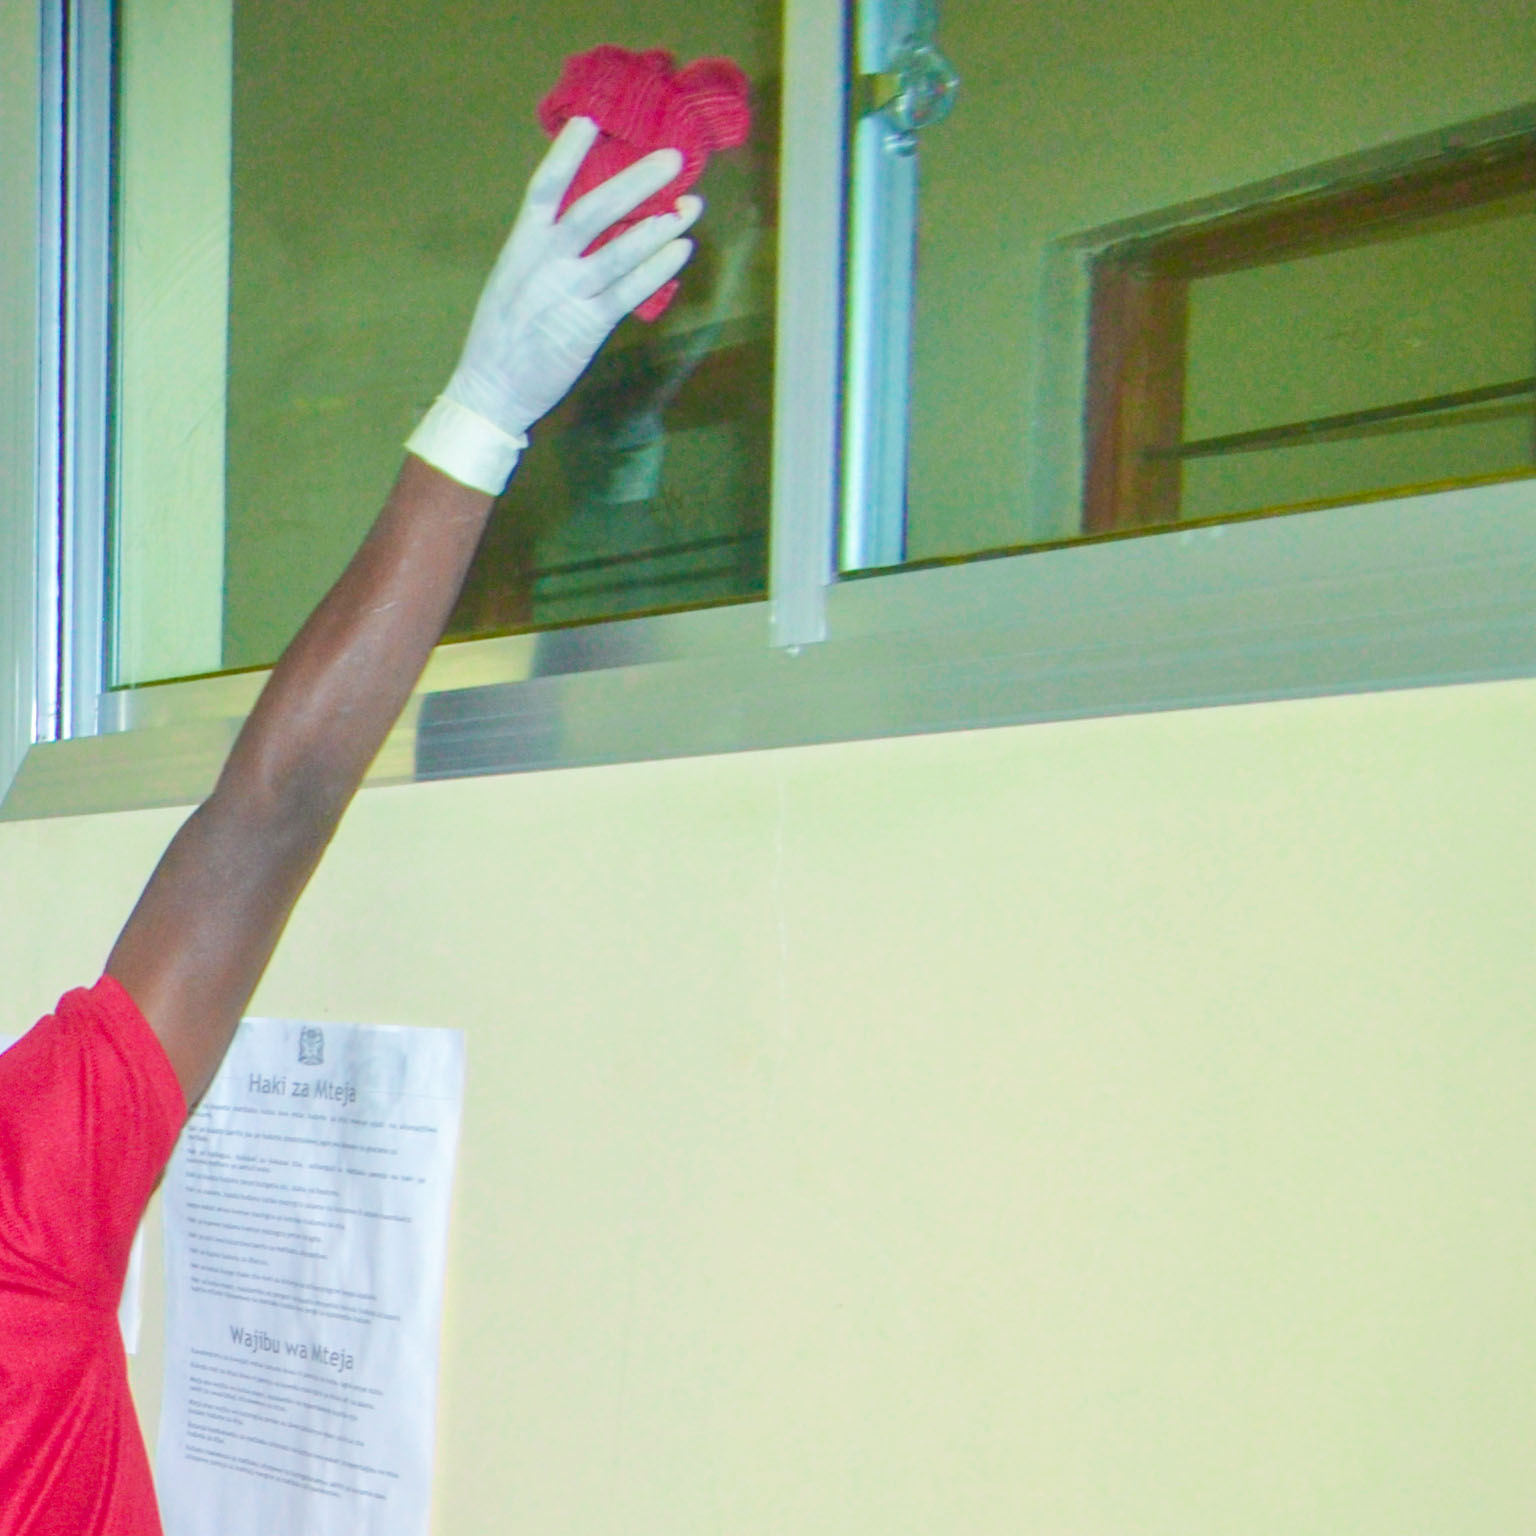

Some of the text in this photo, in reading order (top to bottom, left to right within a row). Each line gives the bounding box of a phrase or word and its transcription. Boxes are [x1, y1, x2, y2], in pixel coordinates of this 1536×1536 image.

[248, 1073, 356, 1107] Haki za Mteja
[229, 1325, 355, 1373] Wajibu wa Mteja
